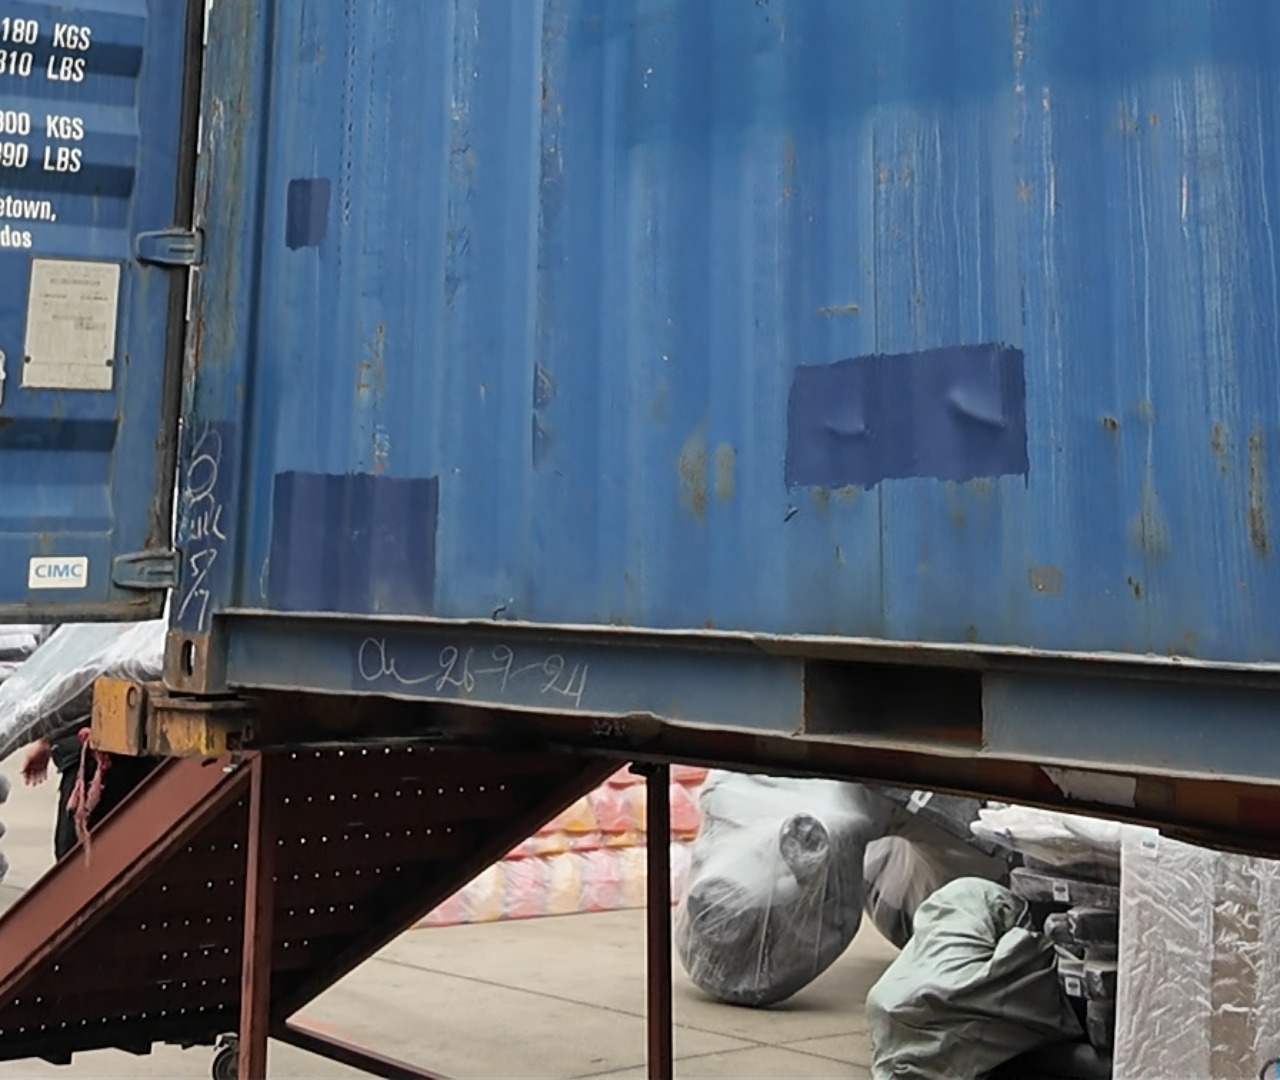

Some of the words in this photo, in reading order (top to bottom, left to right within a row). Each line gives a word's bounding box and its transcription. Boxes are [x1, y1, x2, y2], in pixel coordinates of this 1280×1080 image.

[2, 16, 39, 44] 180
[53, 22, 91, 51] KGS
[47, 55, 85, 82] LBS
[46, 114, 84, 141] KGS
[43, 145, 82, 172] LBS
[35, 563, 84, 579] CIMC
